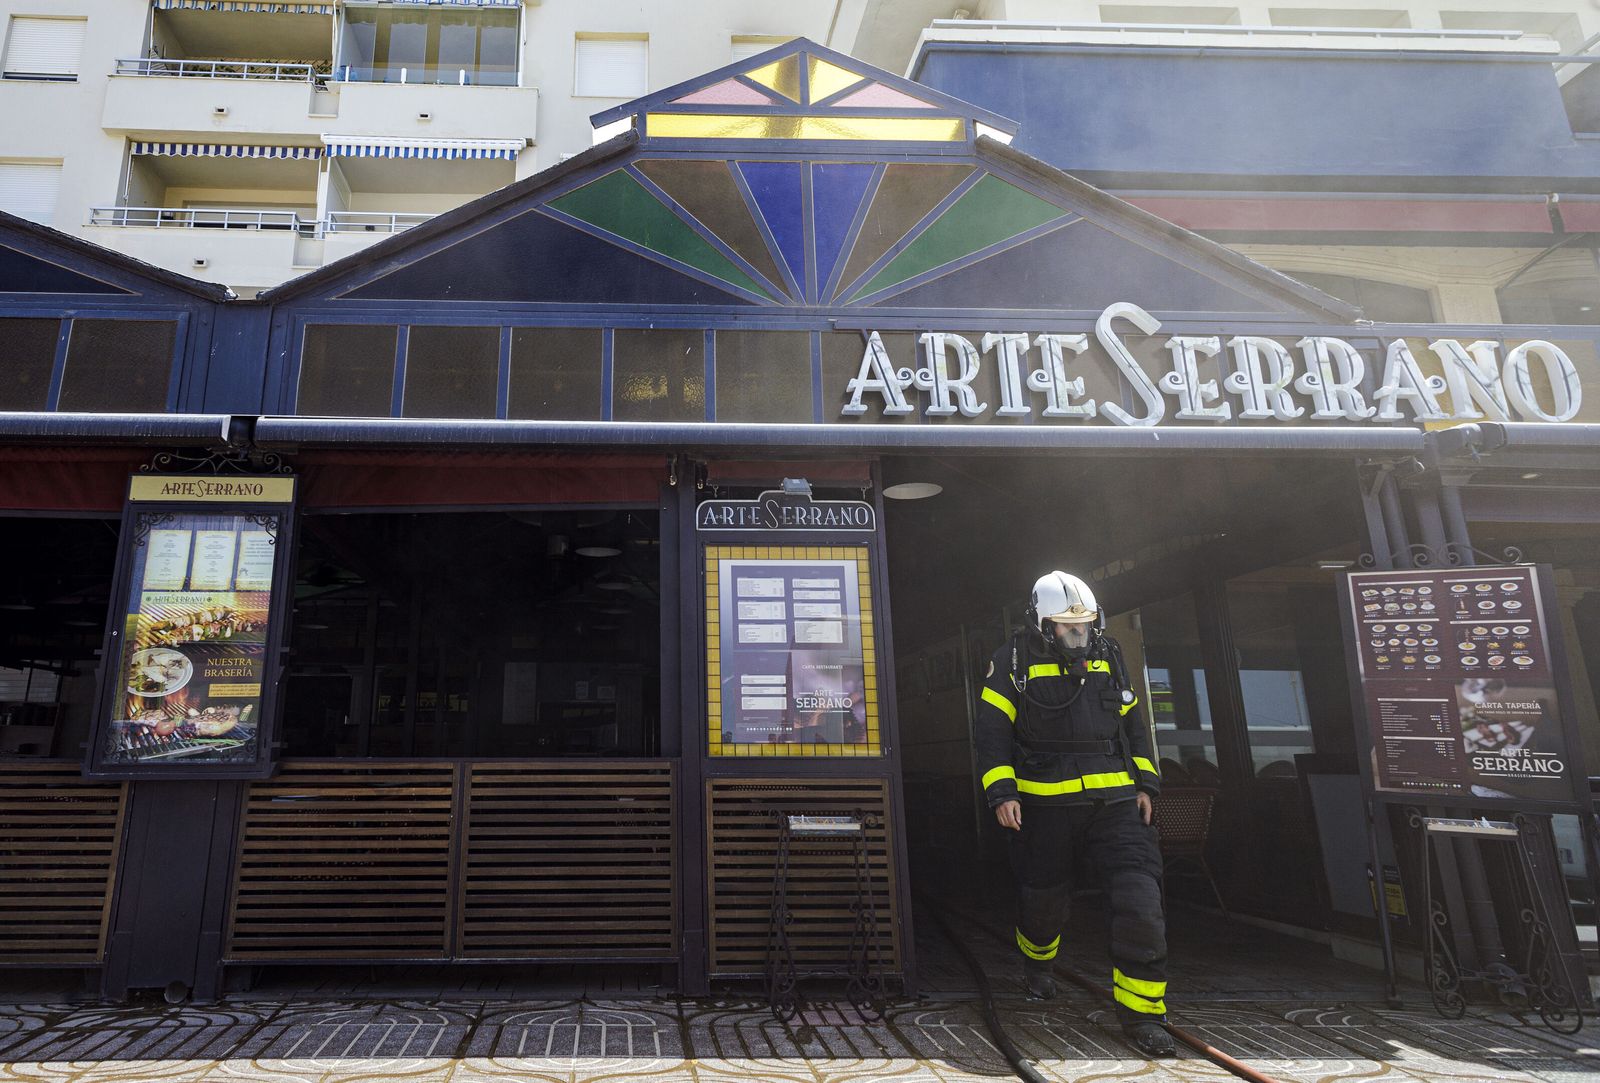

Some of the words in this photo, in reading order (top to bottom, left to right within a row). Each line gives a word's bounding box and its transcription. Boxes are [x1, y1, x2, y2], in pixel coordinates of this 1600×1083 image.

[207, 658, 252, 666] NUESTRA
[204, 667, 253, 677] BRASERÍA
[814, 689, 834, 697] ARTE
[796, 697, 853, 708] SERRANO
[1500, 748, 1531, 757] ARTE
[1472, 757, 1564, 773] SERRANO
